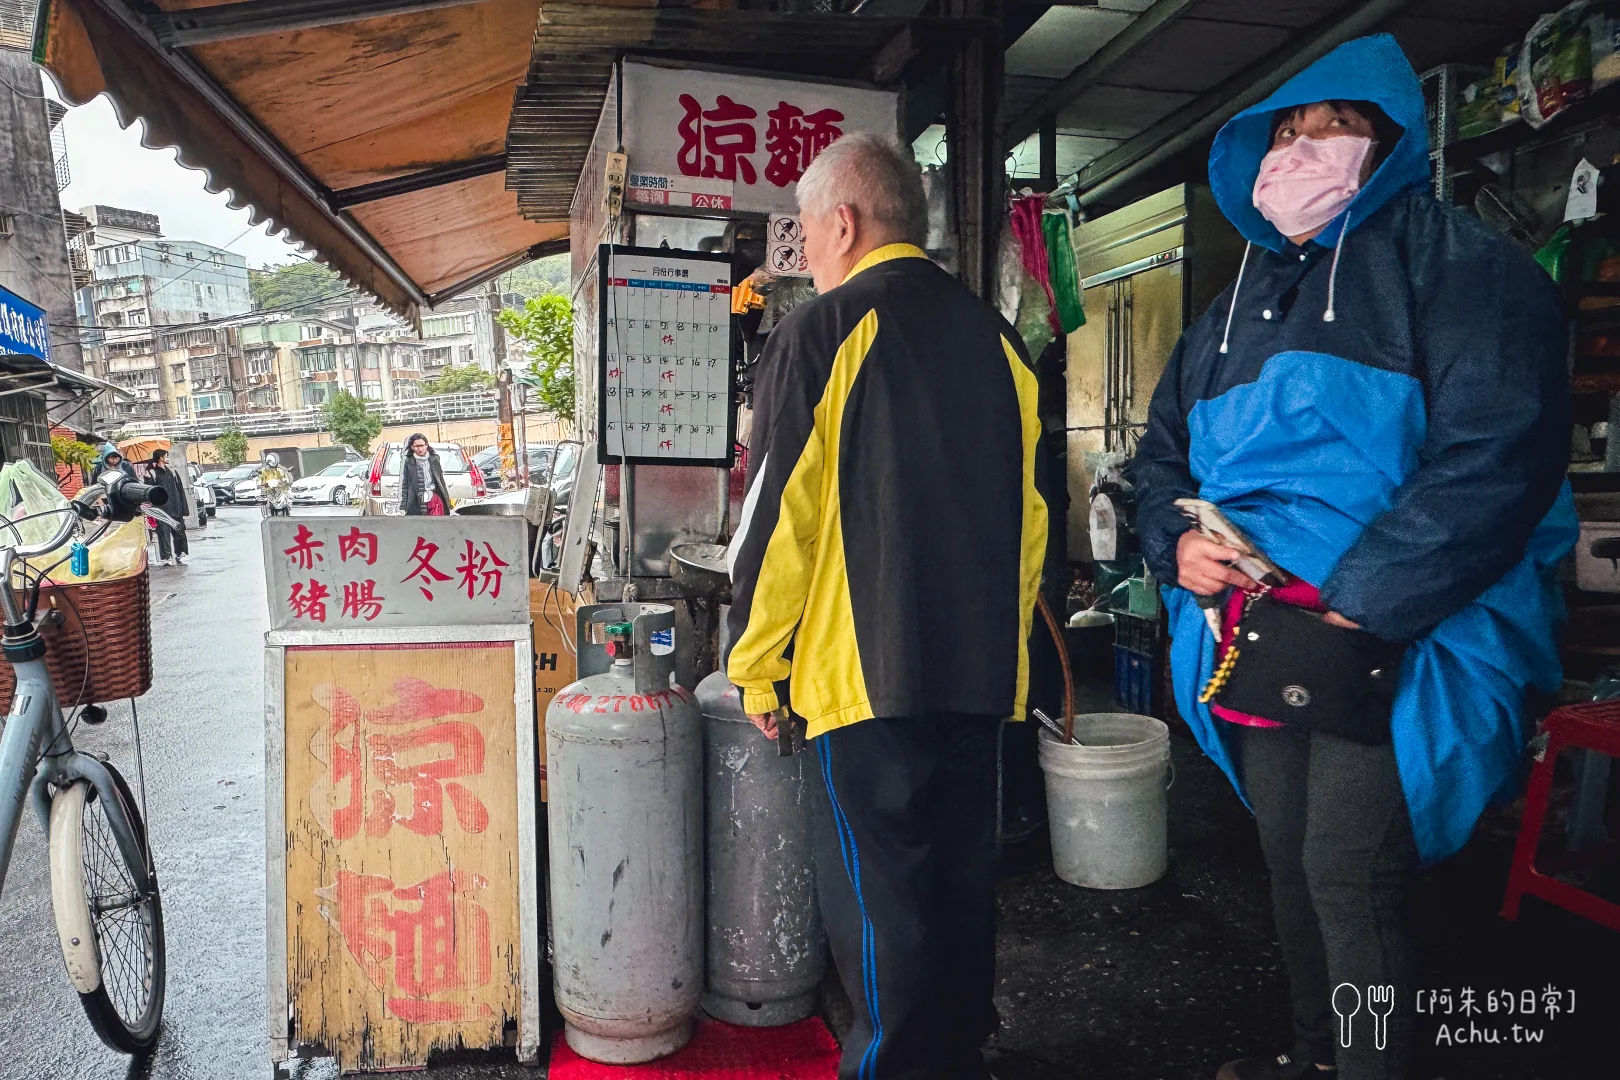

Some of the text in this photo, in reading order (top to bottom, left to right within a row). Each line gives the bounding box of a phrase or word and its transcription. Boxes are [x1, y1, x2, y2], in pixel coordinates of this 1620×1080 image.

[677, 94, 845, 187] 涼麵
[695, 195, 725, 209] 公休
[284, 524, 510, 602] 赤肉 冬粉
[287, 578, 386, 624] 豬腸
